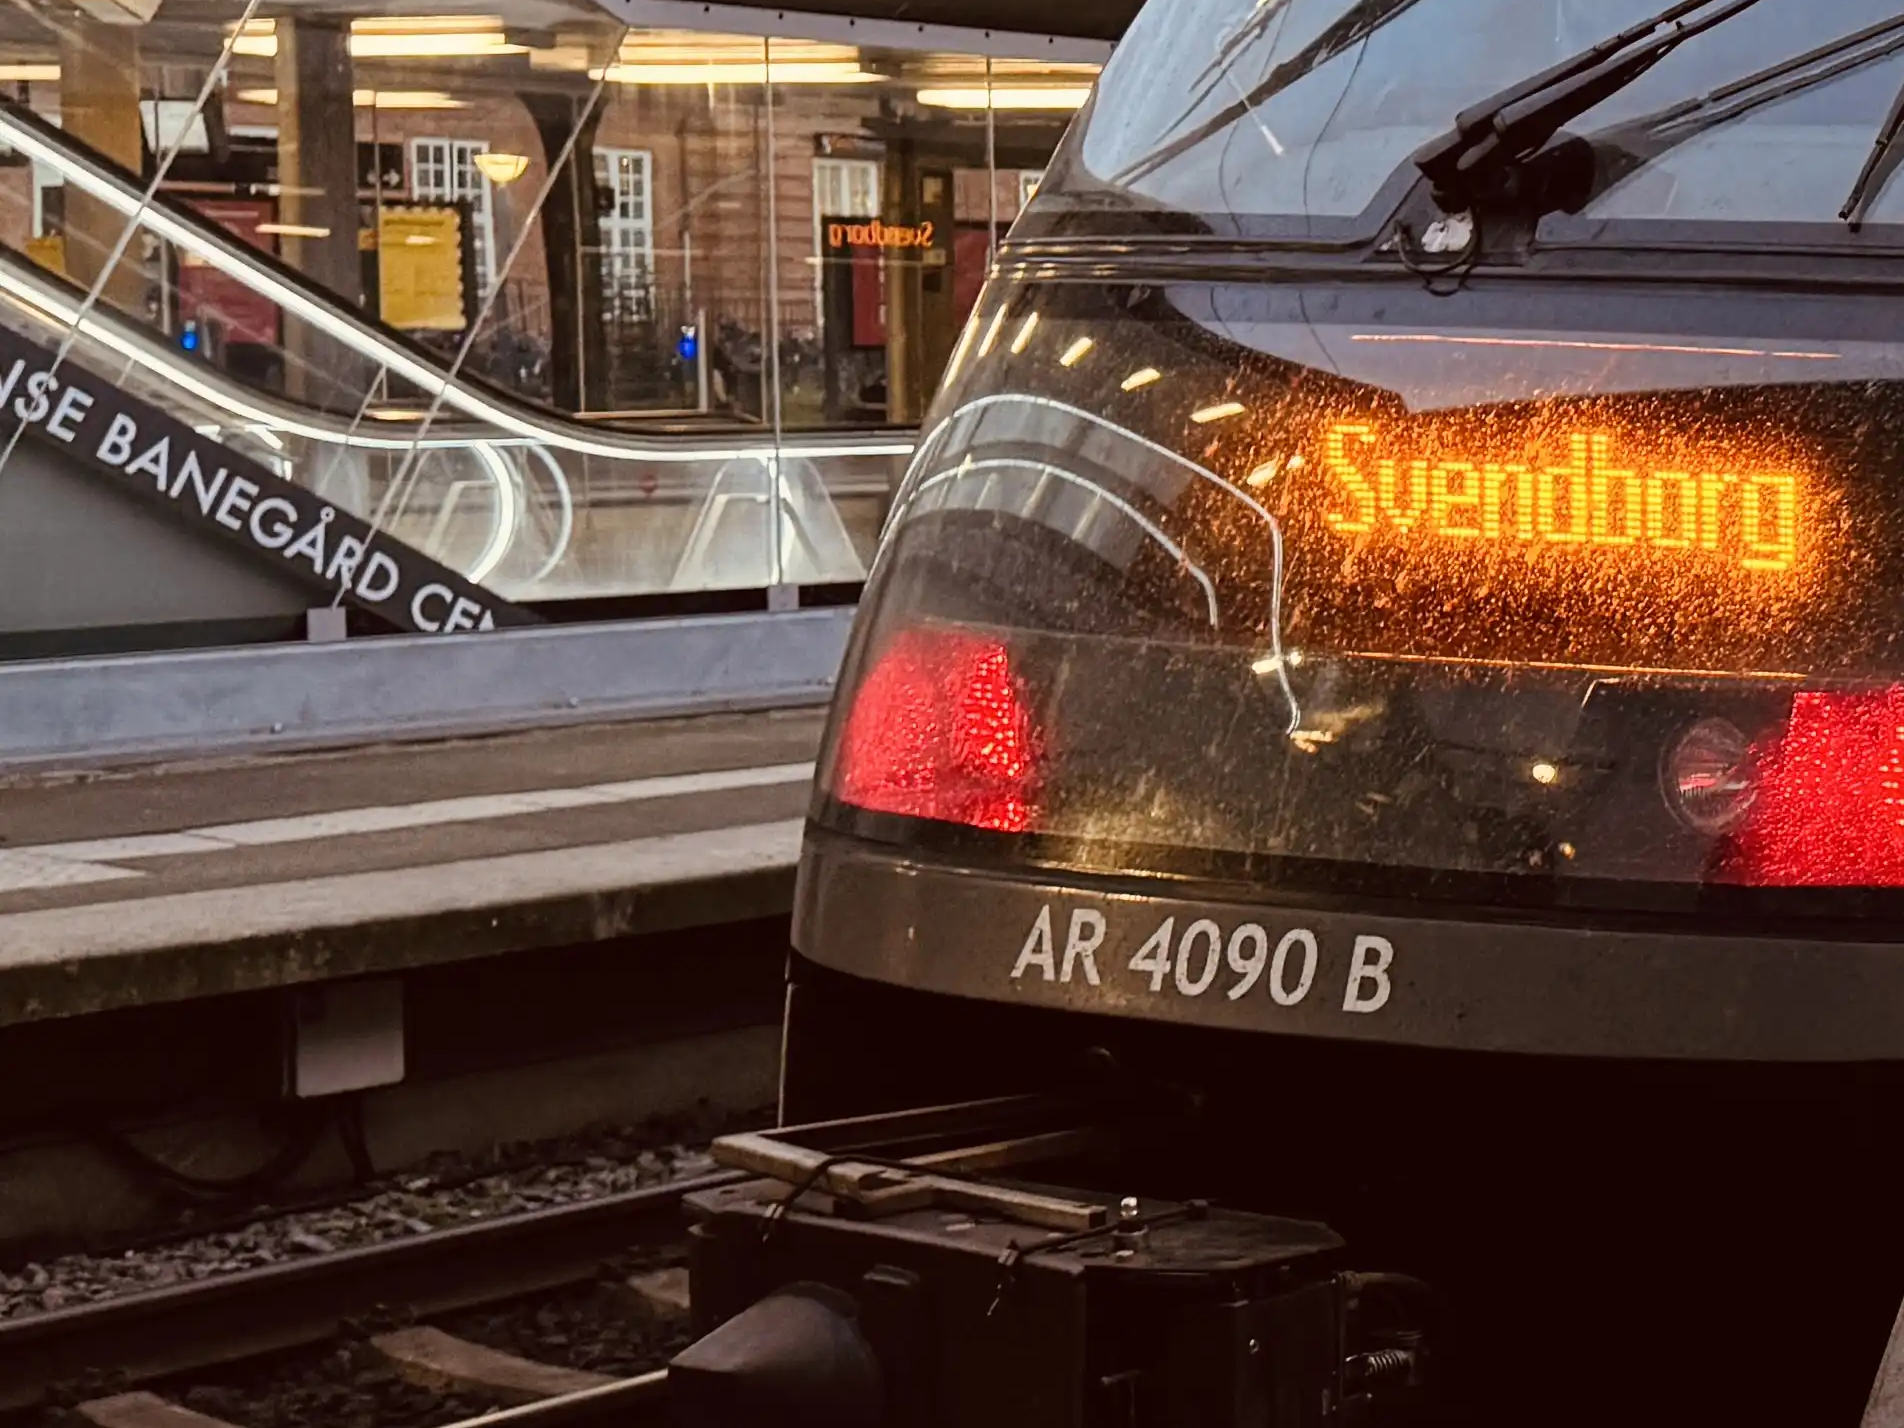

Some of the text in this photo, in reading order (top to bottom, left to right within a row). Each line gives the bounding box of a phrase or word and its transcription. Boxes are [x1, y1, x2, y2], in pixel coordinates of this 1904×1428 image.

[96, 413, 400, 603] BANEGÅRD
[1327, 424, 1795, 570] Svendborg
[1010, 903, 1394, 1014] AR 4090 B
